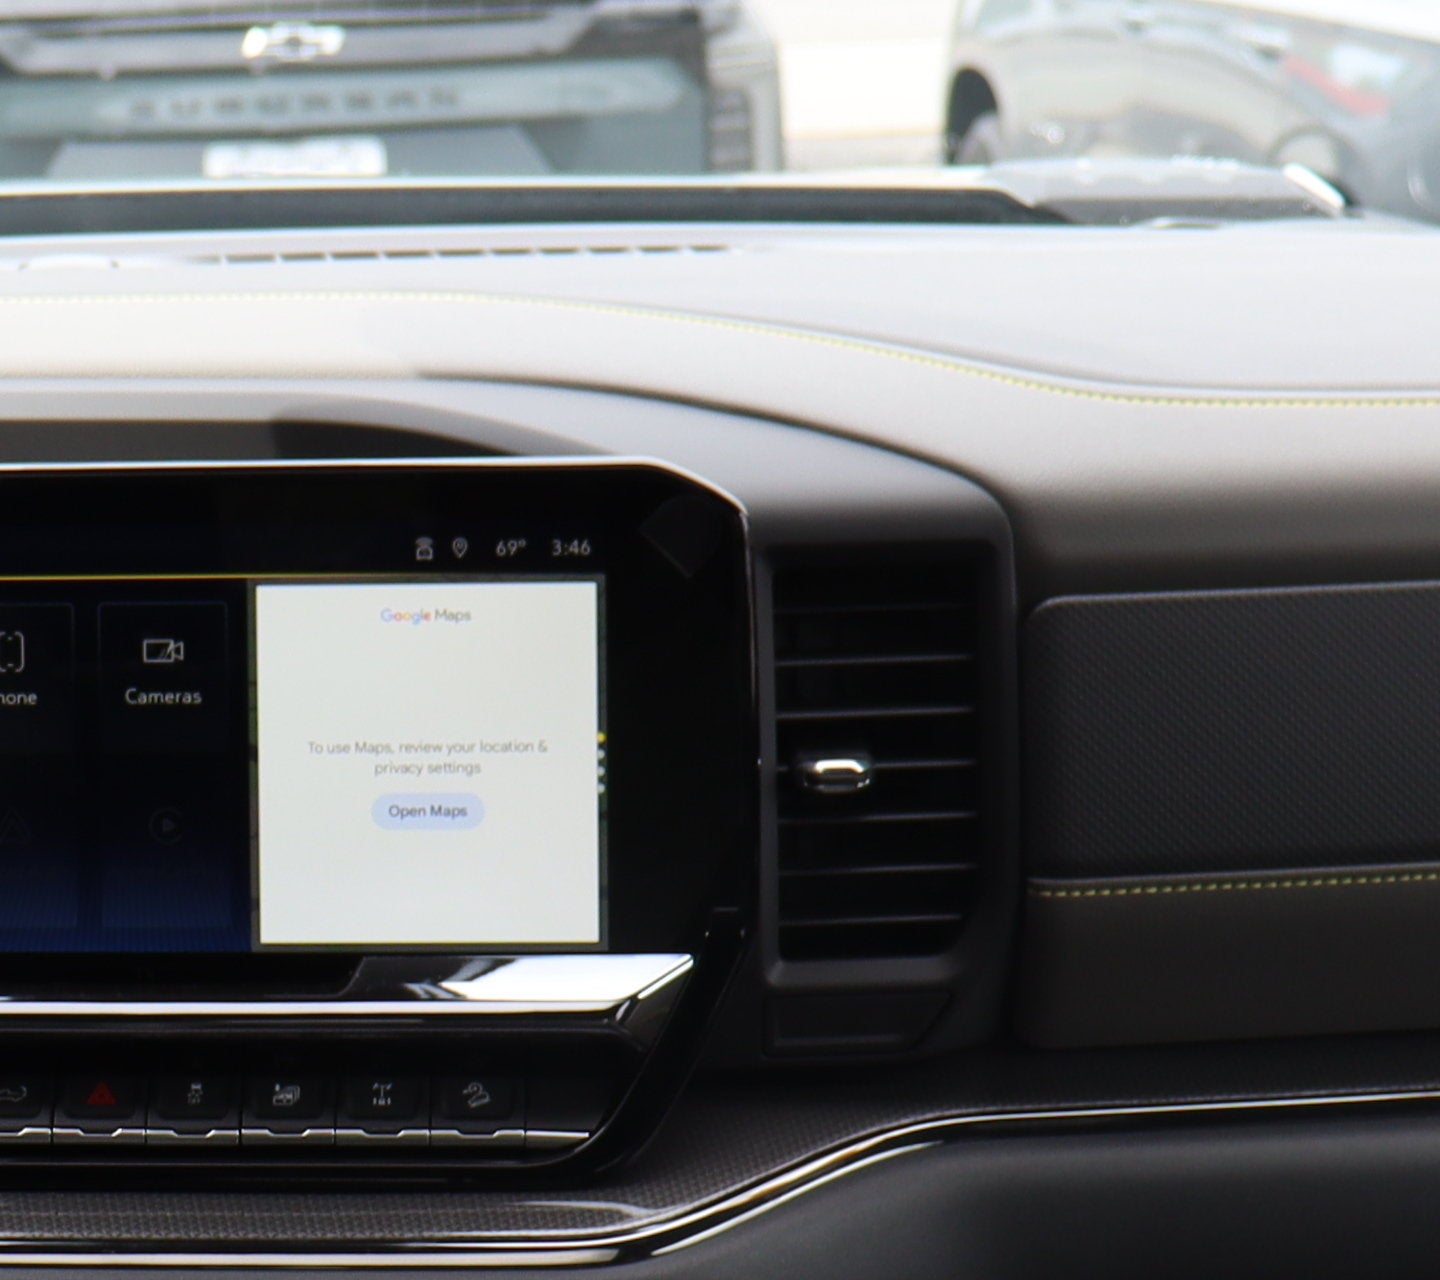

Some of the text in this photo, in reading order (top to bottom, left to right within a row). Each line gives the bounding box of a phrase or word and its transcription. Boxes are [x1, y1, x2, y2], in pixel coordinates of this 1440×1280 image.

[551, 539, 591, 557] 3:46
[380, 608, 472, 625] Google Maps
[124, 687, 202, 706] Cameras
[308, 739, 548, 758] To use Maps, review your location &
[374, 760, 482, 777] privacy settings
[388, 804, 468, 821] Open Maps
